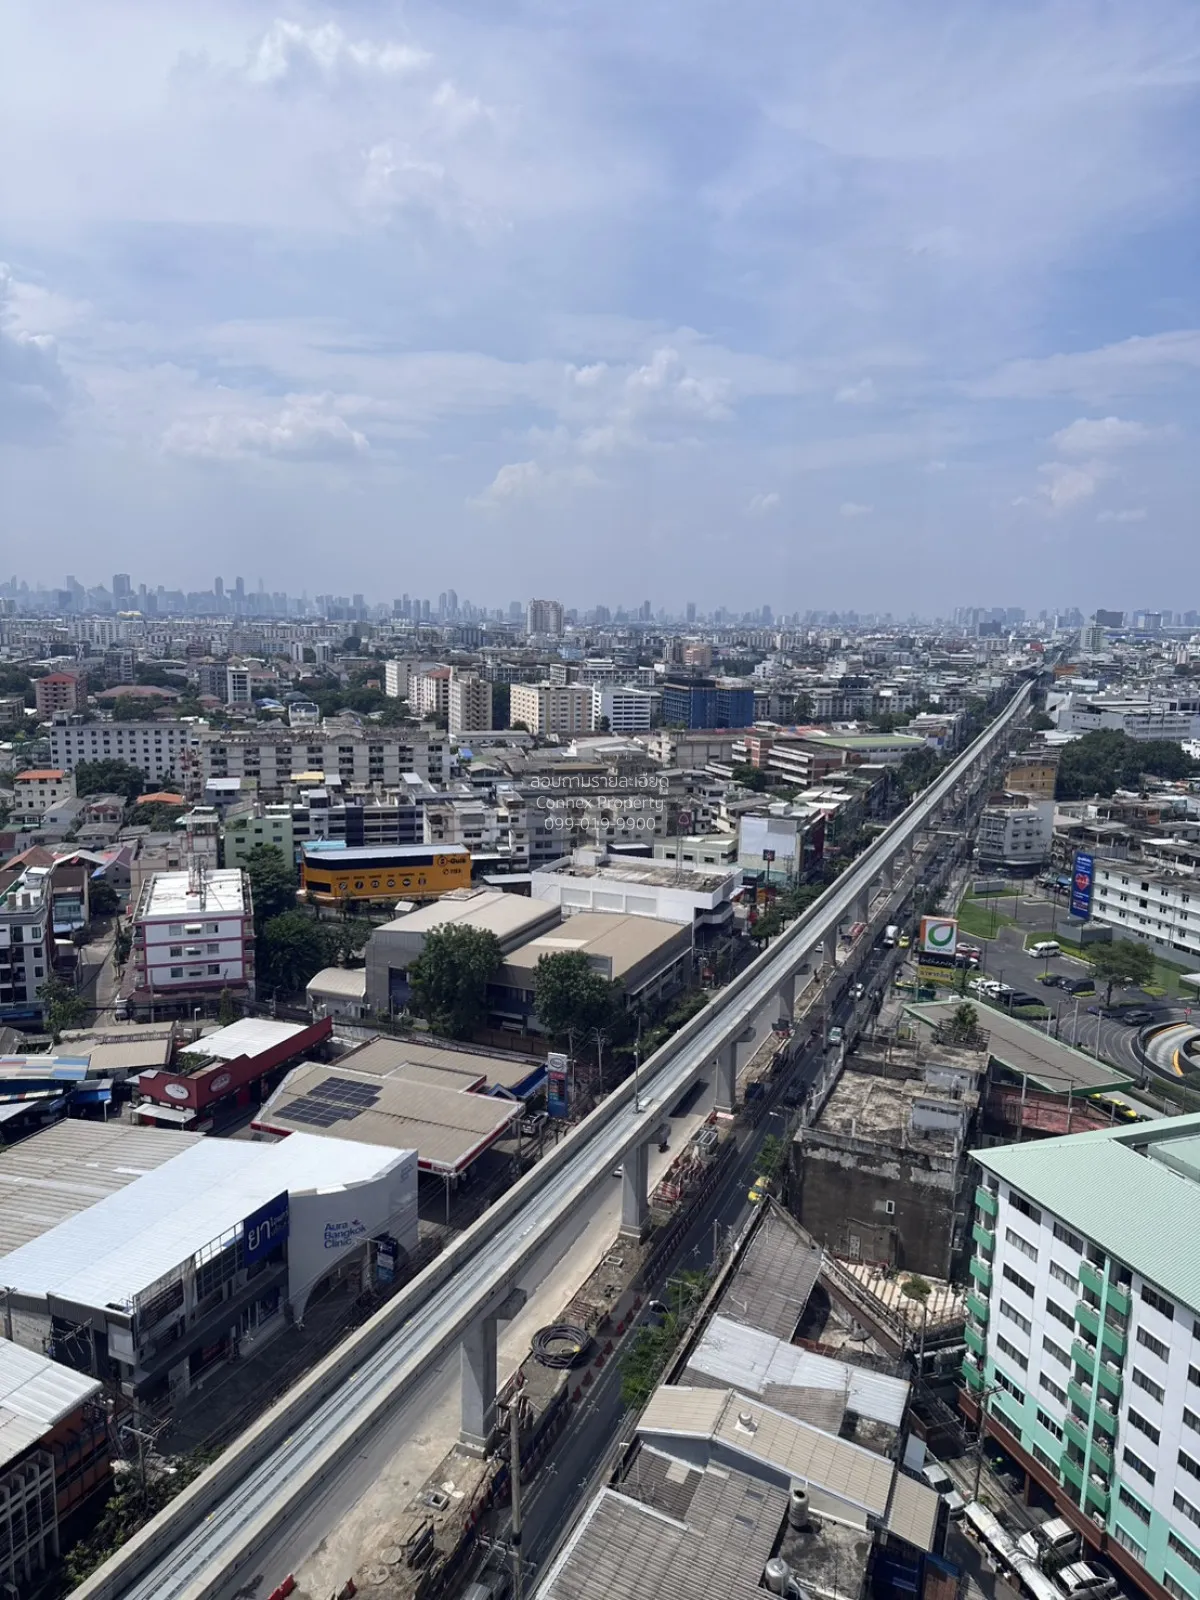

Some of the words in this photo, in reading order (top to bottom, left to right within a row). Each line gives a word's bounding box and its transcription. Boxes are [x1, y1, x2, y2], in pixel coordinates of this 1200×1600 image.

[324, 1222, 348, 1232] Aura
[324, 1225, 367, 1240] Bangkok
[324, 1238, 353, 1249] Clinic
